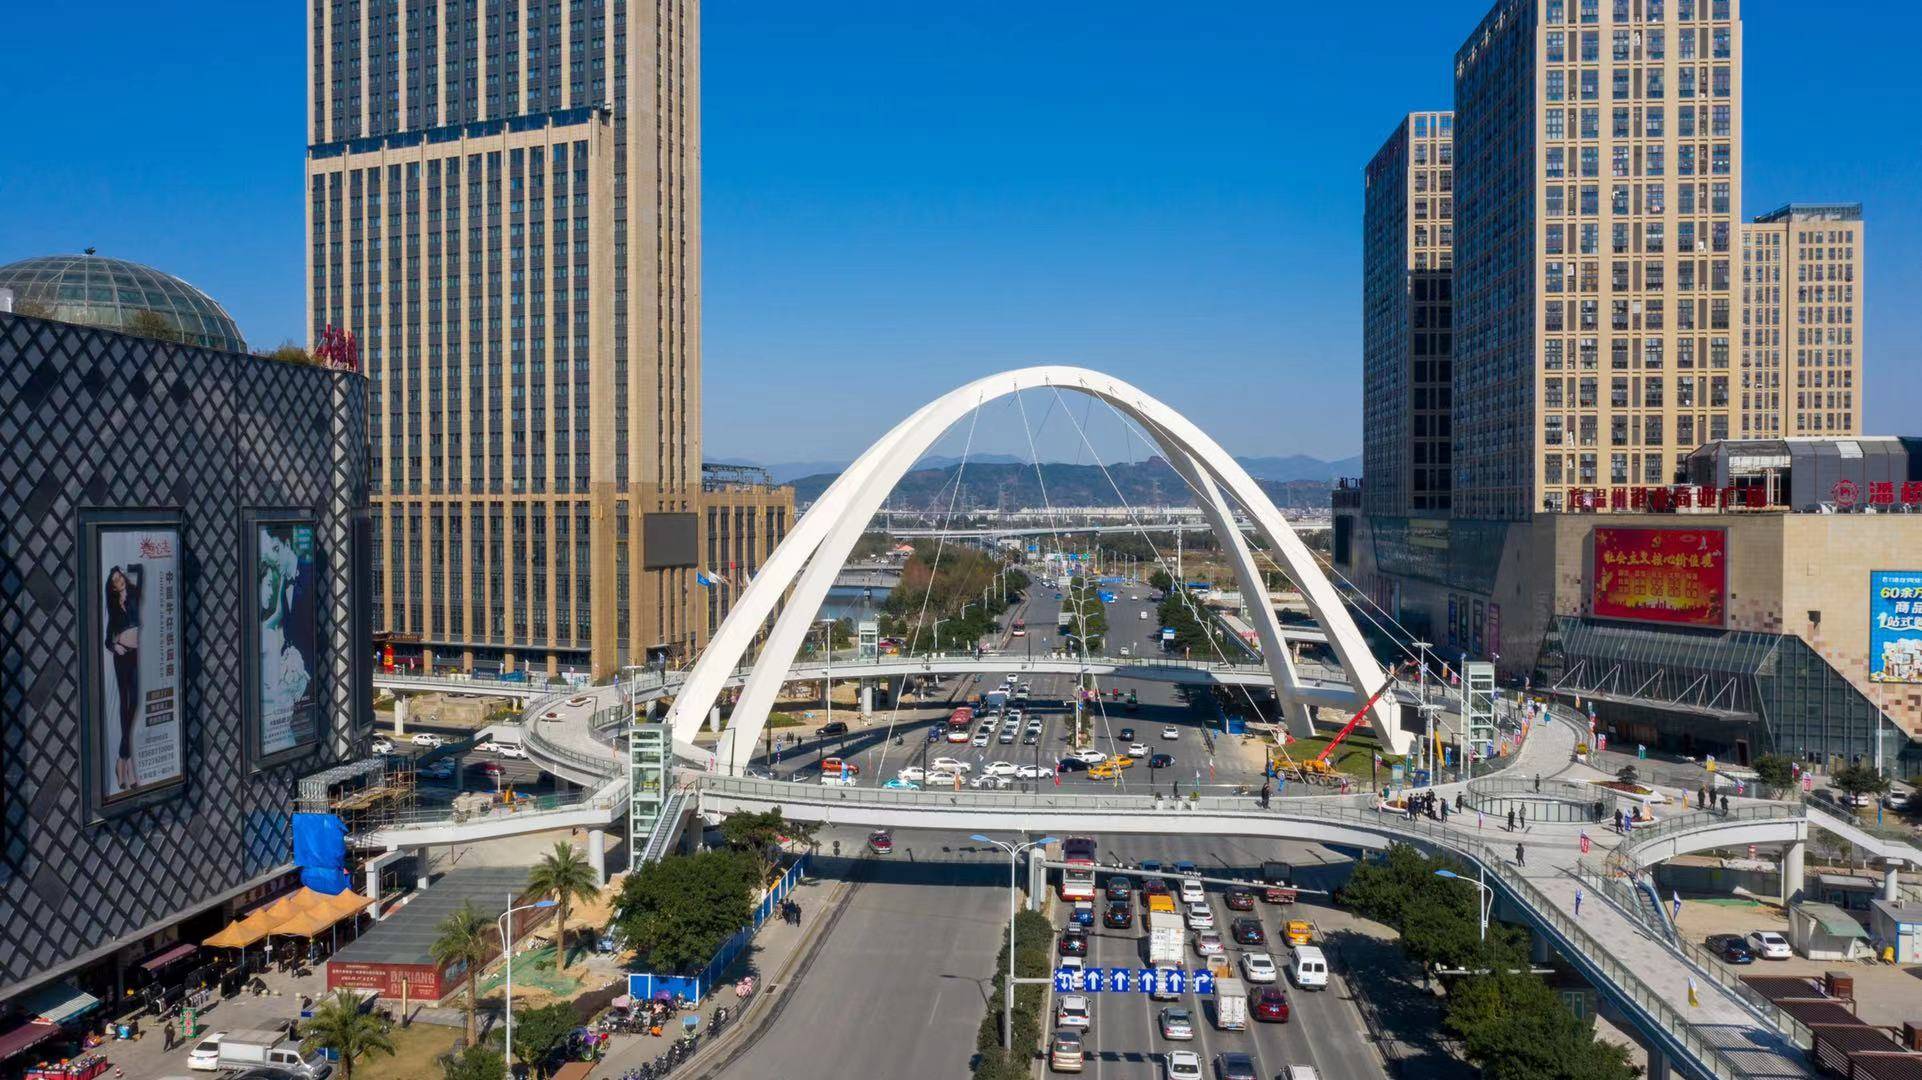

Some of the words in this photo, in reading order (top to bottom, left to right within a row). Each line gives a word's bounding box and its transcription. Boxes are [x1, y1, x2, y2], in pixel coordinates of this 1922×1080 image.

[1603, 550, 1714, 568] 社会主义核心价值观
